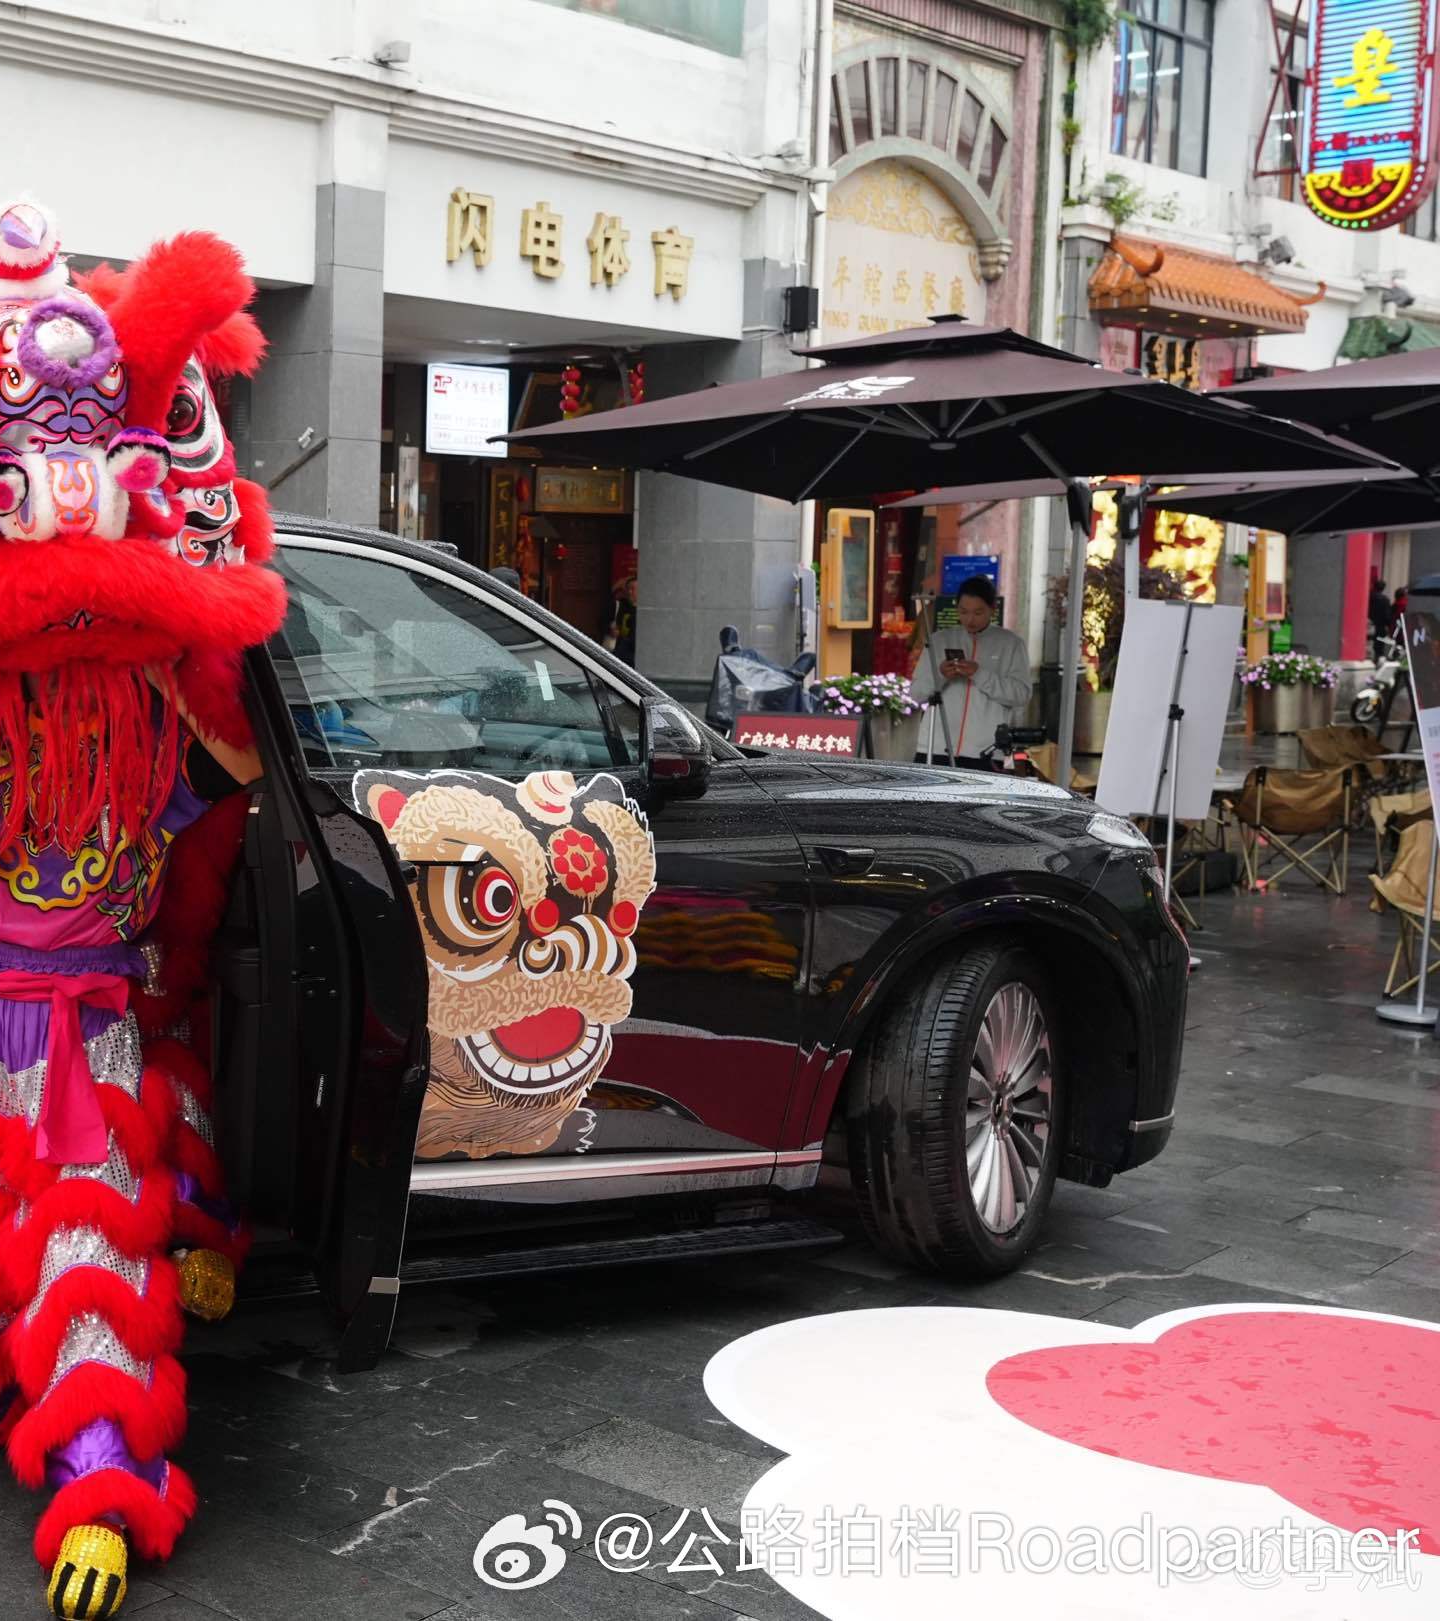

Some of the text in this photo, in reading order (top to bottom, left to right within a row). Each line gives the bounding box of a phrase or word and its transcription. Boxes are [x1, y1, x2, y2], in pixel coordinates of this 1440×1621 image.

[1331, 27, 1400, 108] 皇
[446, 186, 695, 302] 闪电体育
[739, 731, 853, 752] 广府年味·陈皮拿铁
